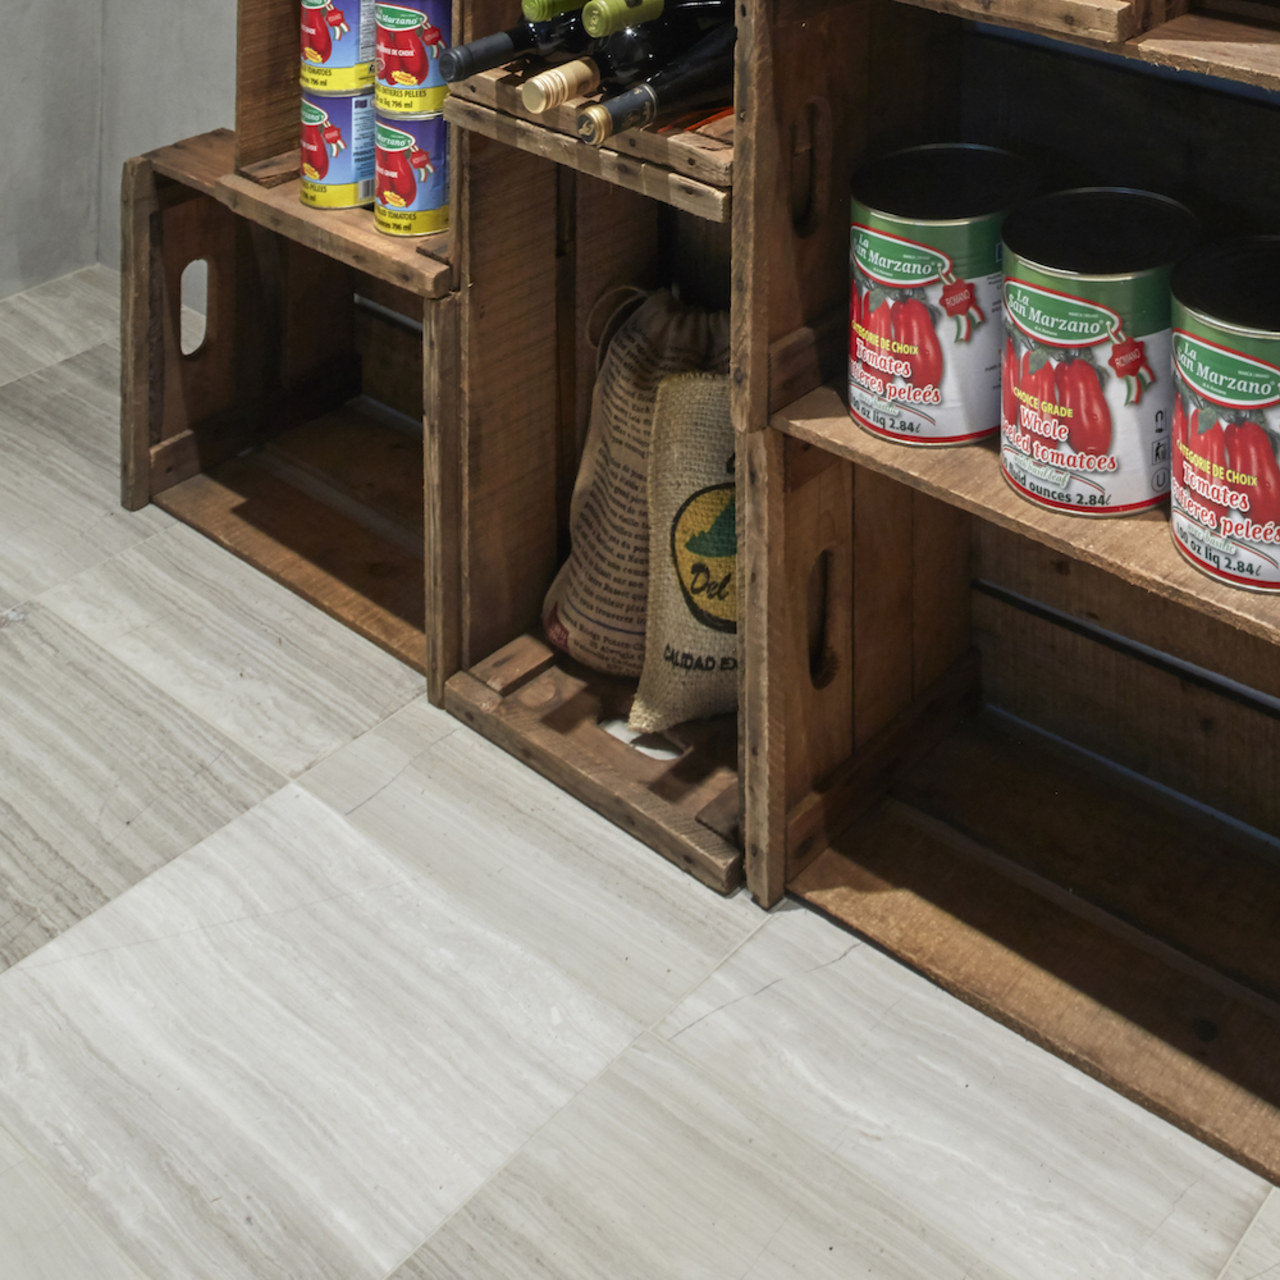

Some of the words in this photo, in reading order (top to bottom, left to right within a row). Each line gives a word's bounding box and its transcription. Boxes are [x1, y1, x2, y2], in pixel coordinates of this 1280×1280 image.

[868, 251, 932, 275] Marzano
[1017, 289, 1029, 306] La
[1008, 293, 1027, 318] San
[1028, 307, 1101, 335] Marzano
[856, 337, 912, 378] Tomates
[880, 338, 891, 352] DE
[891, 342, 919, 355] CHOIX
[1184, 342, 1197, 361] La
[1196, 362, 1272, 396] Marzano
[886, 384, 942, 405] peleés
[1013, 387, 1039, 408] CHOICE
[1041, 401, 1073, 418] GRADE
[873, 410, 886, 429] liq
[1020, 405, 1069, 441] Whole
[1033, 442, 1118, 472] tomatoes
[1183, 460, 1250, 511] Tomates
[1212, 463, 1224, 480] DE
[1226, 469, 1258, 487] CHOIX
[1029, 481, 1072, 504] ounces
[1190, 540, 1202, 555] oz
[1204, 546, 1221, 571] liq
[690, 562, 731, 600] Del
